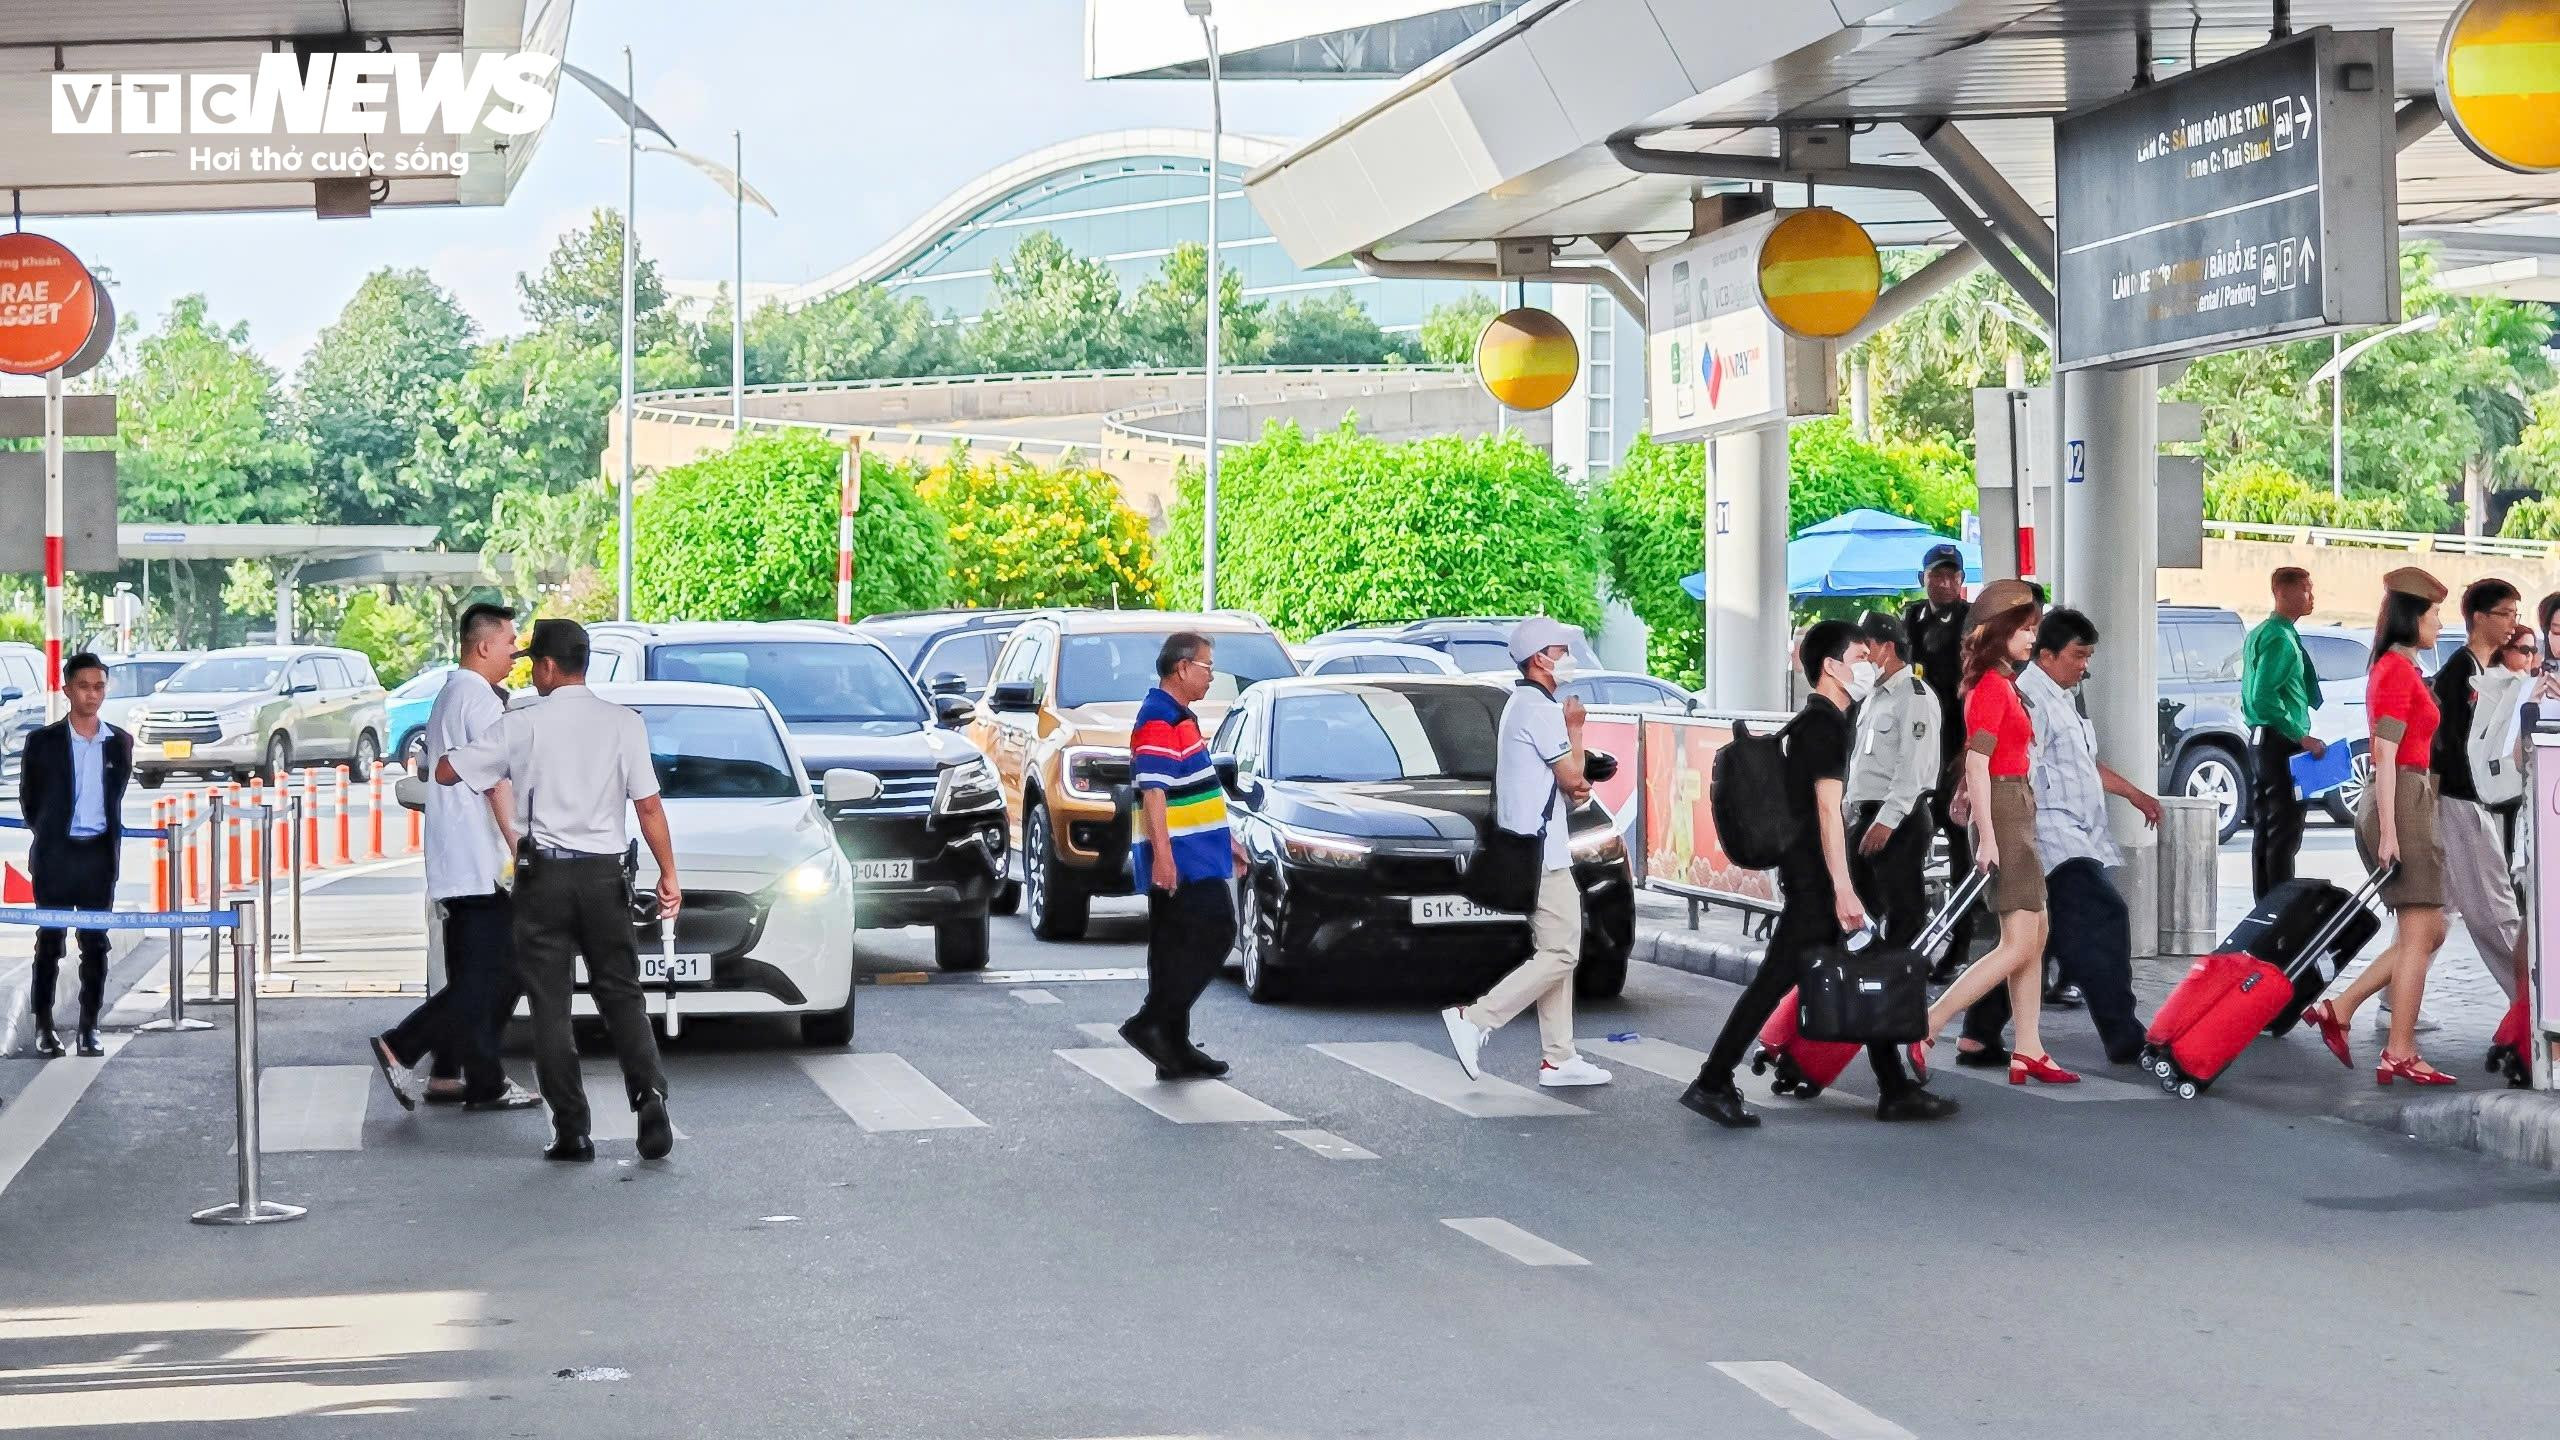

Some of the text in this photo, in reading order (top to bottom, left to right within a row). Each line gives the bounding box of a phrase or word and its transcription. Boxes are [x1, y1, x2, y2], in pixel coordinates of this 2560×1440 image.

[2172, 118, 2203, 152] SẢNH
[2204, 111, 2227, 143] ĐÓN
[2228, 109, 2244, 136] XE
[2244, 101, 2269, 131] TAXI
[2222, 143, 2243, 170] Taxi
[2244, 136, 2271, 164] Stand
[2139, 269, 2151, 294] XE
[2243, 246, 2257, 272] XE
[2194, 287, 2219, 312] ental
[2224, 282, 2257, 308] Parking
[0, 303, 63, 326] SSET
